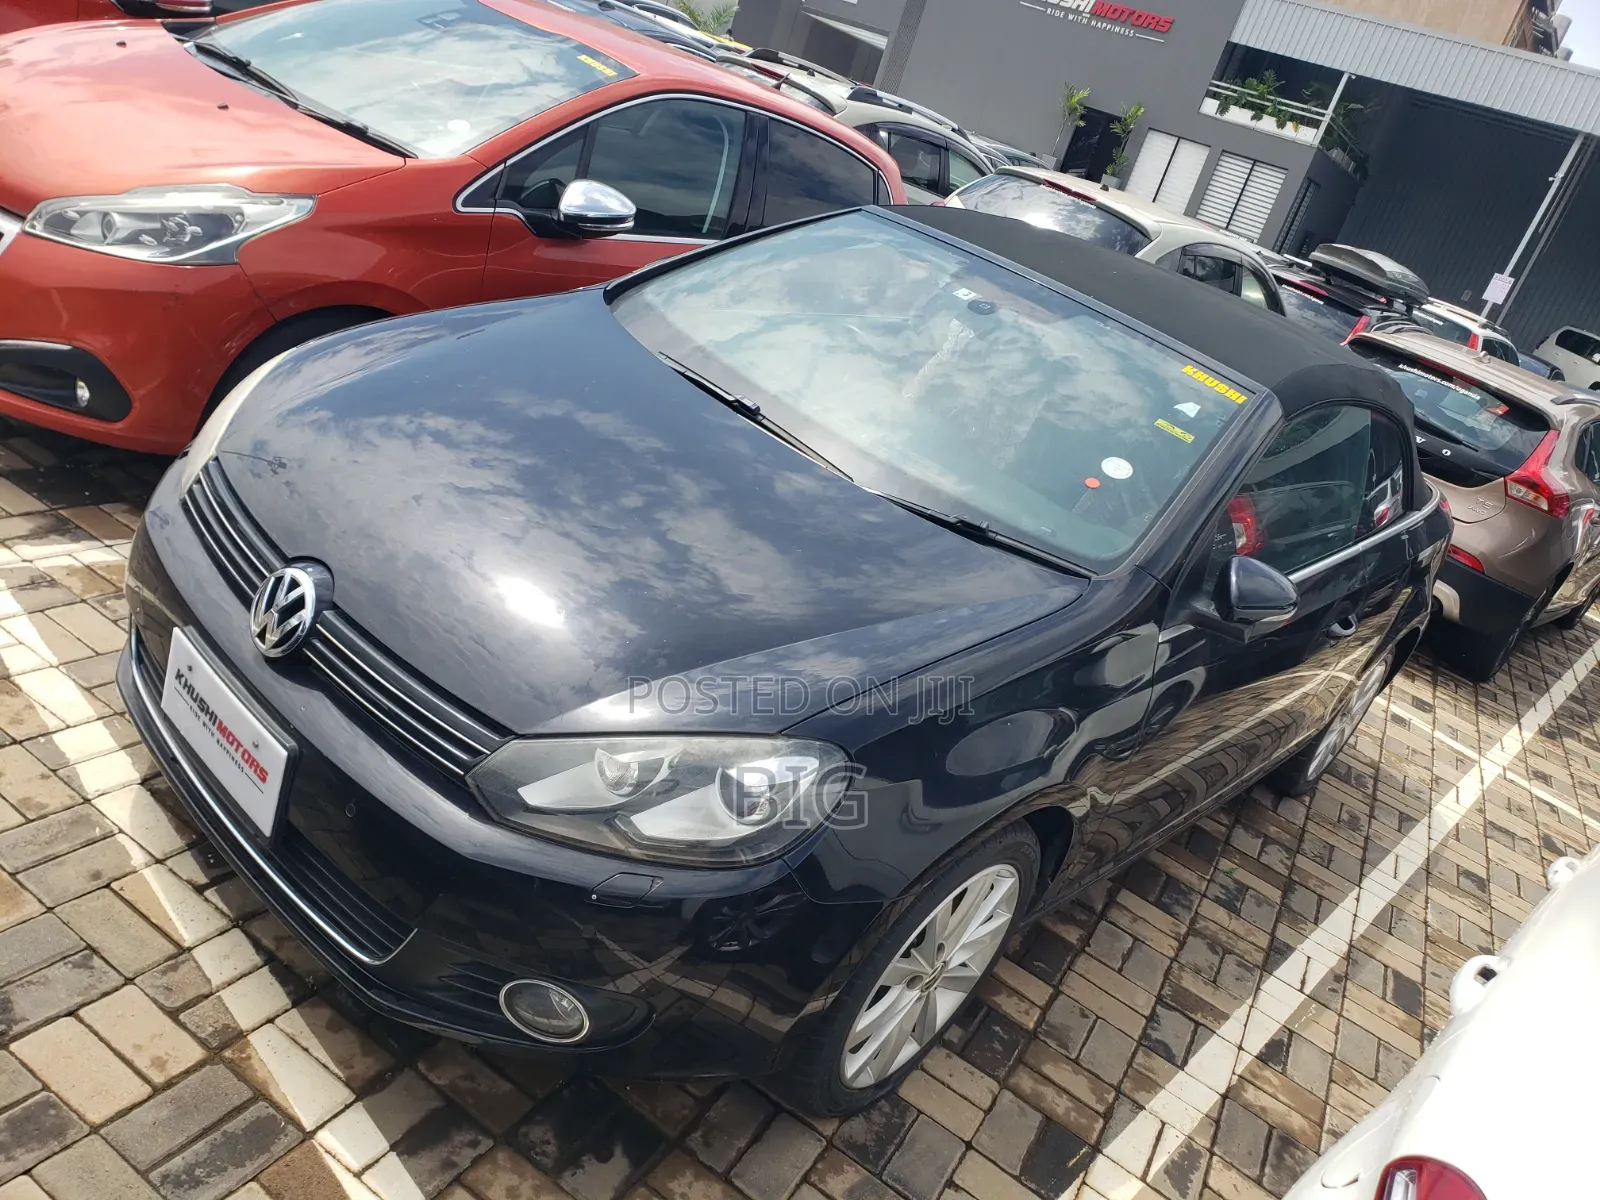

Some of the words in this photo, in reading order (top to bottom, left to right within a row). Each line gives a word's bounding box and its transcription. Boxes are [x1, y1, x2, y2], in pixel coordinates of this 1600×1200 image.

[1046, 7, 1066, 18] RIDE
[1068, 13, 1088, 25] WITH
[1091, 20, 1135, 37] HAPPINESS
[1181, 365, 1247, 405] KHUSHI
